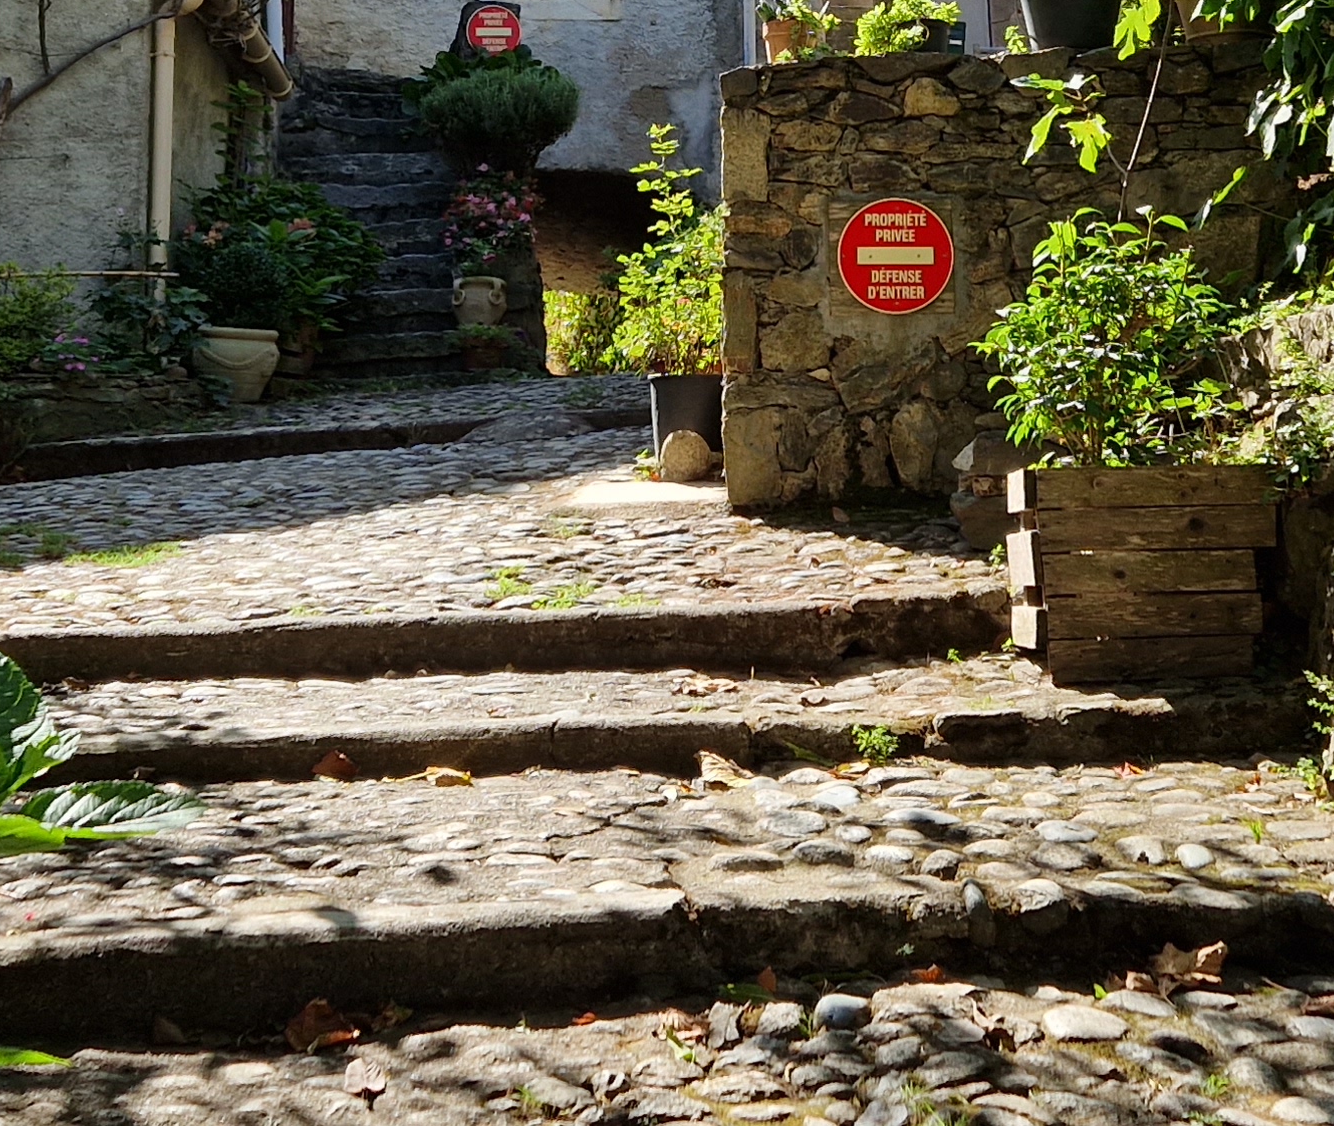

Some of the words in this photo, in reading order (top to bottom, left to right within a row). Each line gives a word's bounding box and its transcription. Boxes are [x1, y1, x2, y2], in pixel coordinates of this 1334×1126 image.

[864, 210, 927, 227] PROPRIÉTÉ
[875, 227, 916, 243] PRIVÉE
[871, 267, 923, 284] DÉFENSE
[867, 285, 925, 300] D'ENTRER
